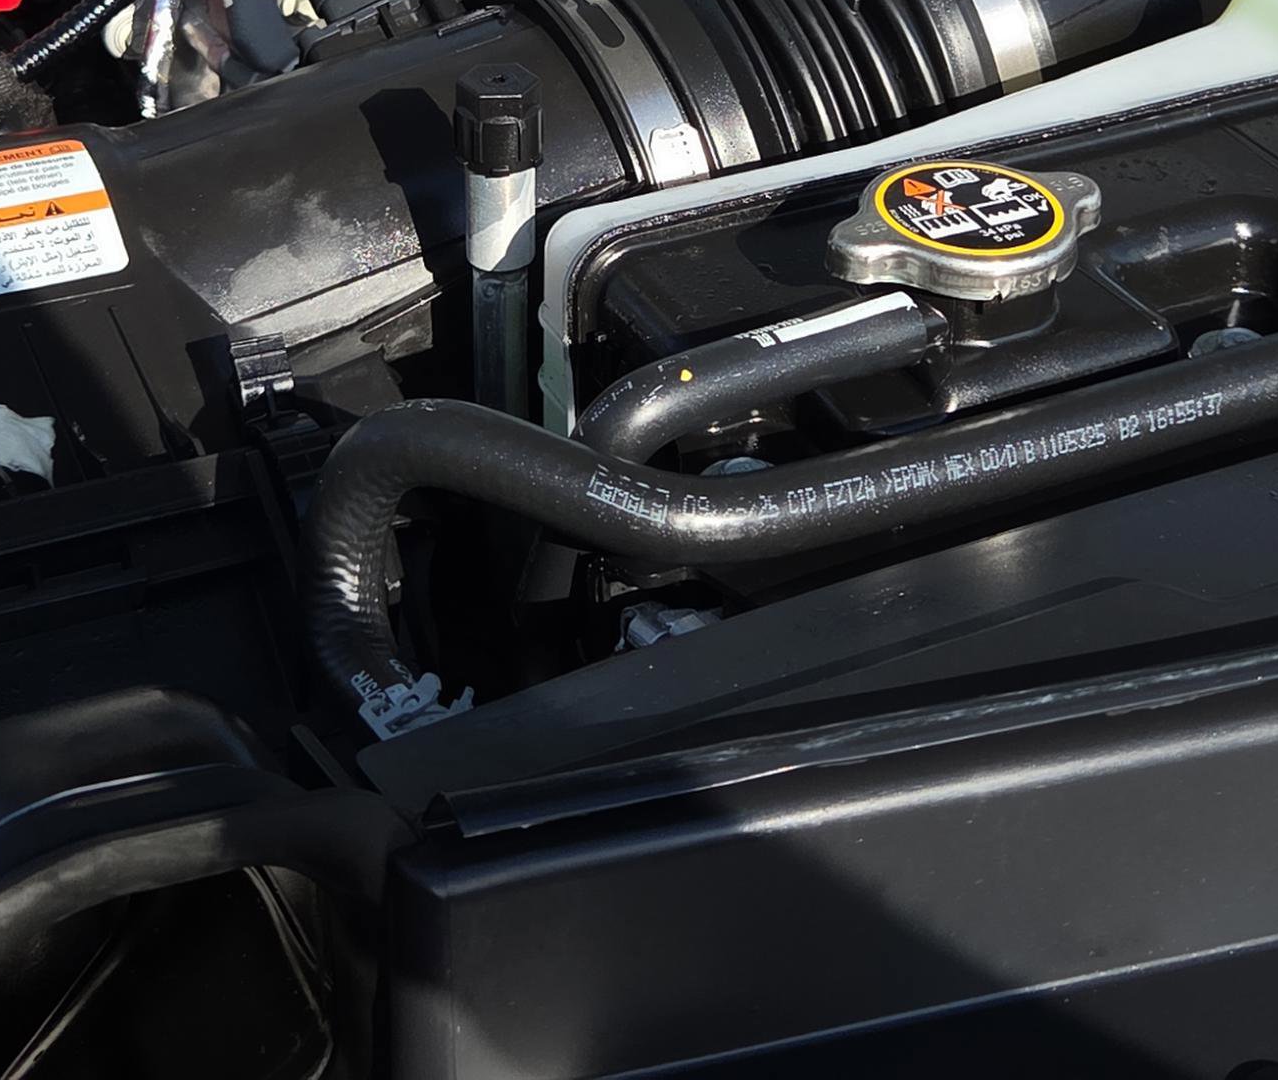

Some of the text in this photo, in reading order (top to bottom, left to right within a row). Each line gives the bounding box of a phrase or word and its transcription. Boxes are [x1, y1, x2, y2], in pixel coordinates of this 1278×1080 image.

[16, 183, 31, 192] de
[31, 177, 71, 190] bougies
[1023, 191, 1045, 204] OK
[978, 223, 1023, 238] 34 kPa
[1006, 231, 1025, 243] psi
[945, 453, 973, 482] MEX
[1024, 440, 1036, 464] B
[1040, 423, 1106, 461] 1105325
[1119, 415, 1141, 441] B2
[1146, 392, 1222, 432] 16:55:37
